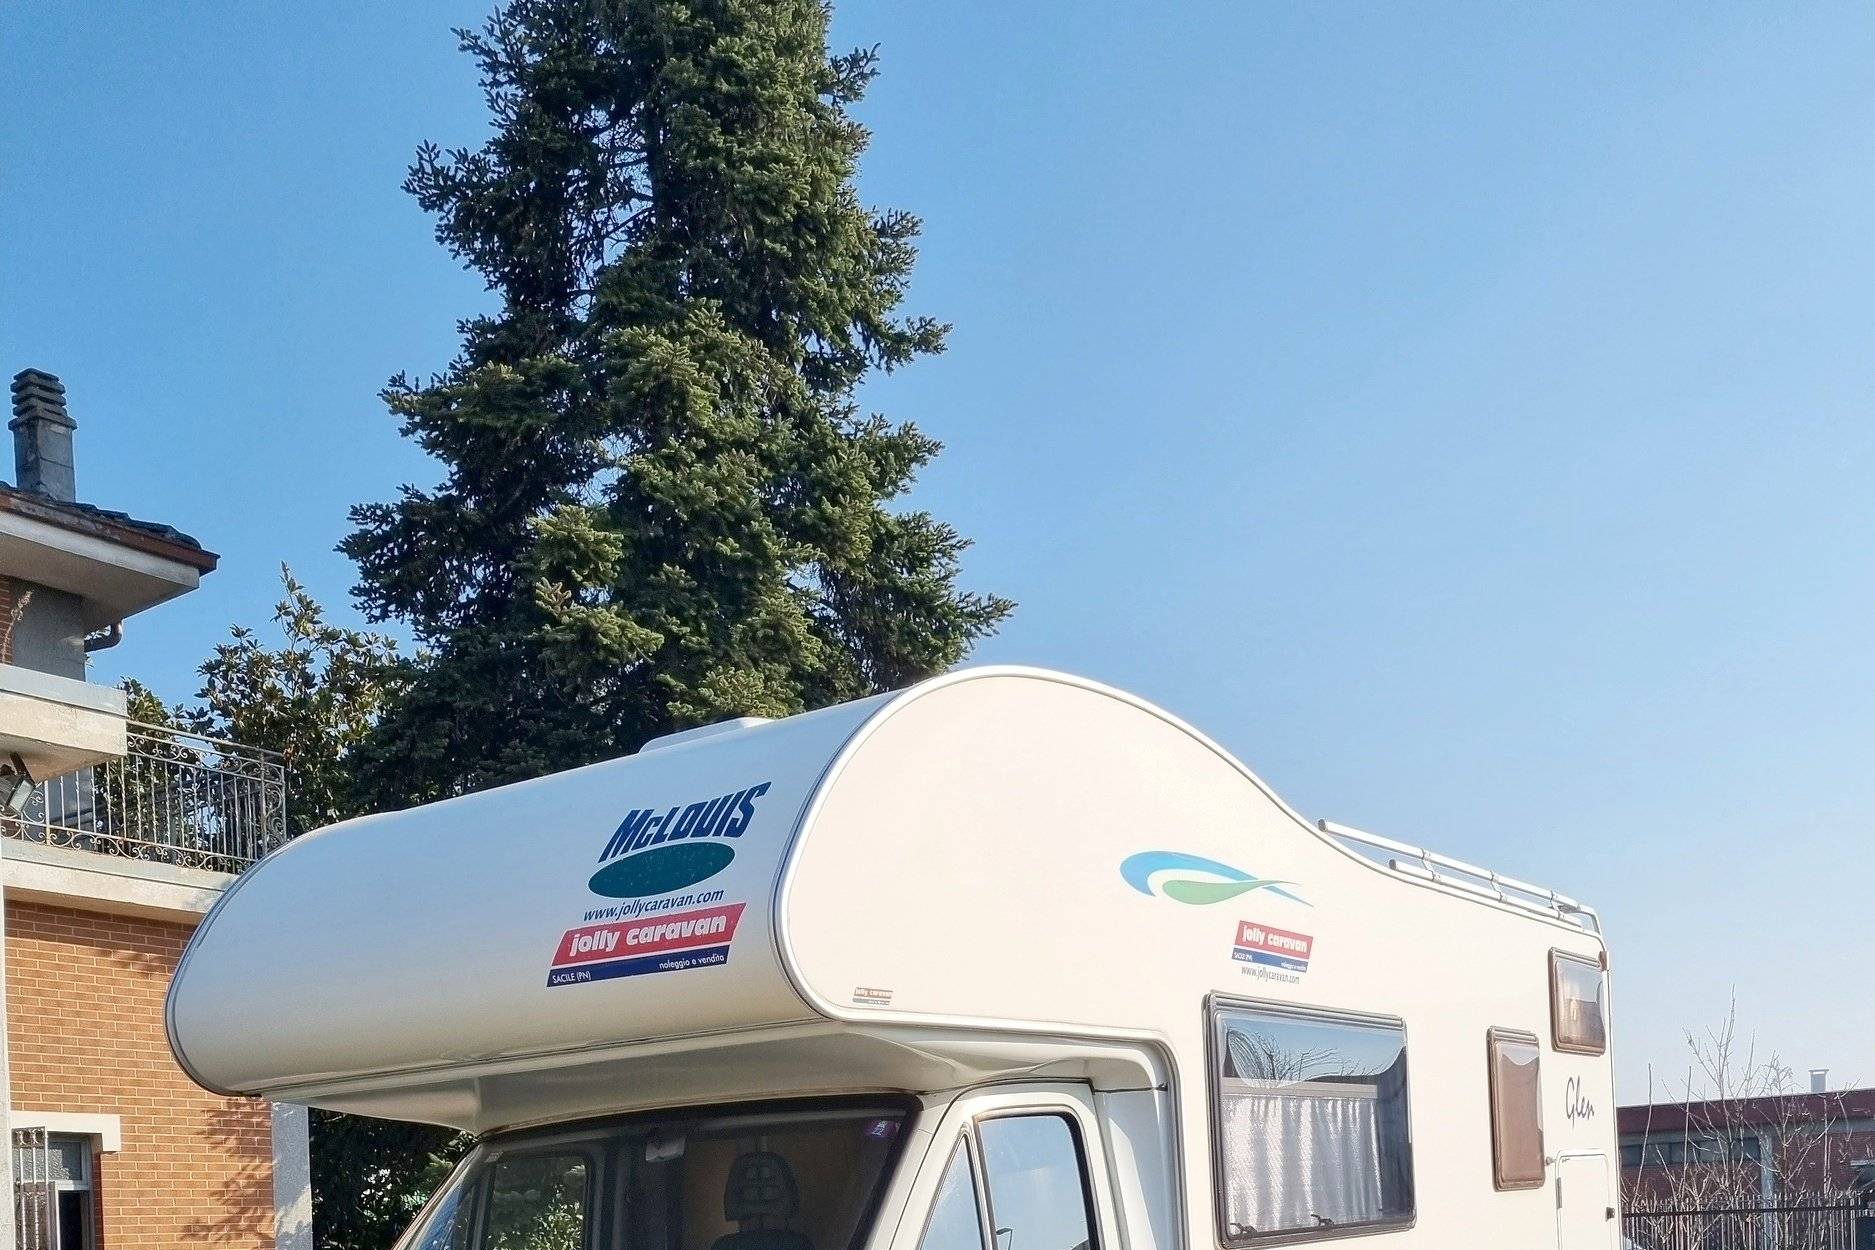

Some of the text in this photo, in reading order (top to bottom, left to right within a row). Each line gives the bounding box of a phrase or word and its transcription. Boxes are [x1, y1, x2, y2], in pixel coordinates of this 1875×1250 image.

[598, 781, 772, 863] McLOUIS
[583, 889, 724, 922] www.jollycaravan.com
[569, 915, 727, 957] jolly caravan
[1242, 924, 1308, 953] jolly caravan
[552, 971, 591, 984] SACILE (PN)
[659, 957, 690, 970] noleggio
[698, 953, 725, 965] vendita
[1565, 1074, 1595, 1128] Glen
